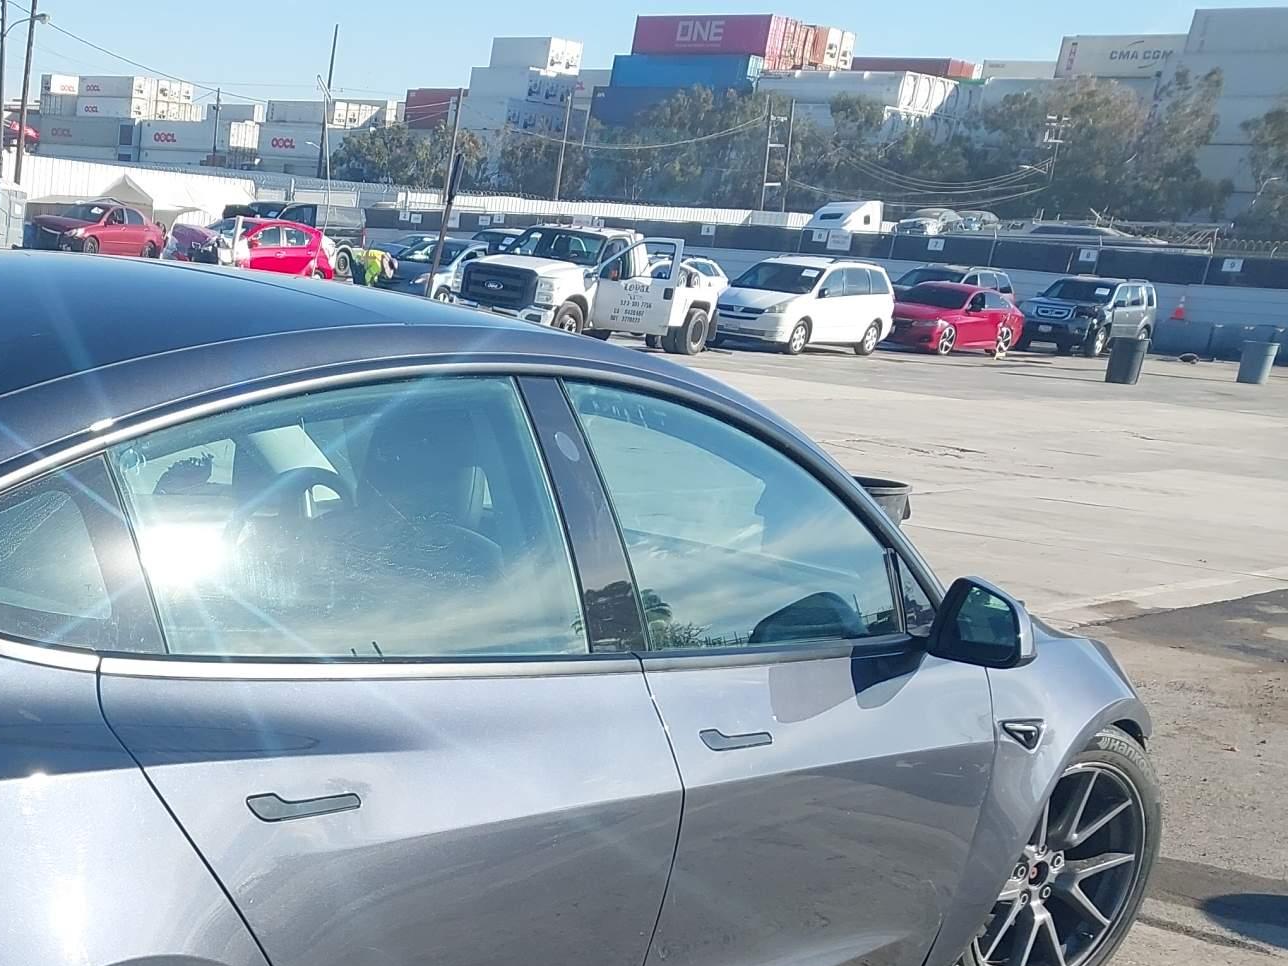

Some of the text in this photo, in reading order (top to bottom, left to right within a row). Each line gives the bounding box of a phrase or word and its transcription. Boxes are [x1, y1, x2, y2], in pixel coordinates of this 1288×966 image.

[676, 20, 725, 41] ONE
[1109, 49, 1173, 60] CMA CGM
[85, 84, 101, 92] OOCL
[84, 105, 99, 113] OOCL
[52, 127, 73, 137] OOCL
[153, 132, 177, 143] OOCL
[271, 137, 296, 149] OOCL
